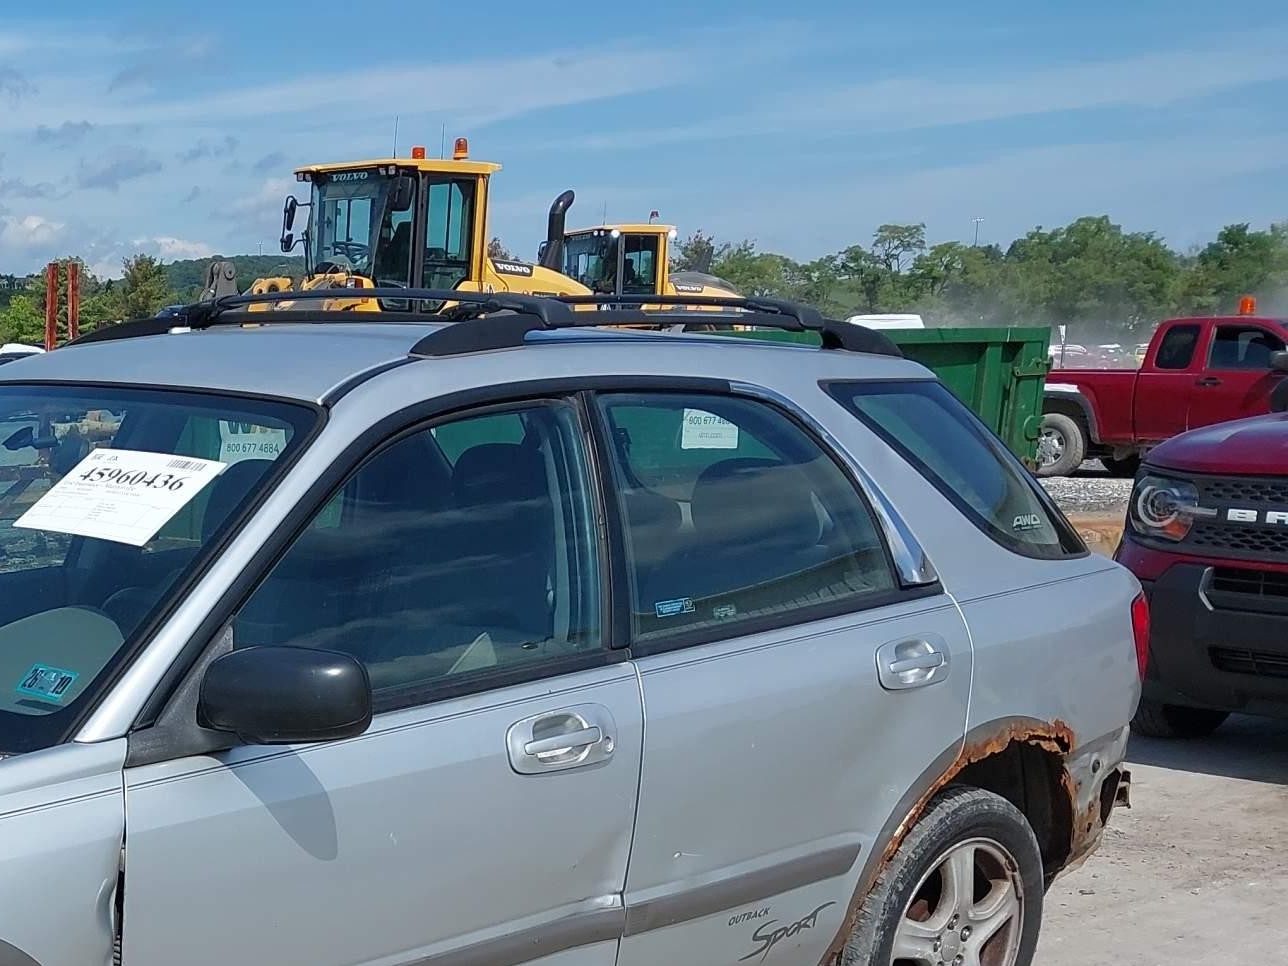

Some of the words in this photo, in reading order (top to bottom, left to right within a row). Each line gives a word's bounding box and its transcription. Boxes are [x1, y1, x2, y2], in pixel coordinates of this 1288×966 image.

[331, 171, 369, 182] VOLVO
[495, 263, 531, 274] VOLVO
[79, 466, 192, 491] 45960436
[1012, 514, 1041, 527] AWD
[728, 907, 770, 926] OUTBACK
